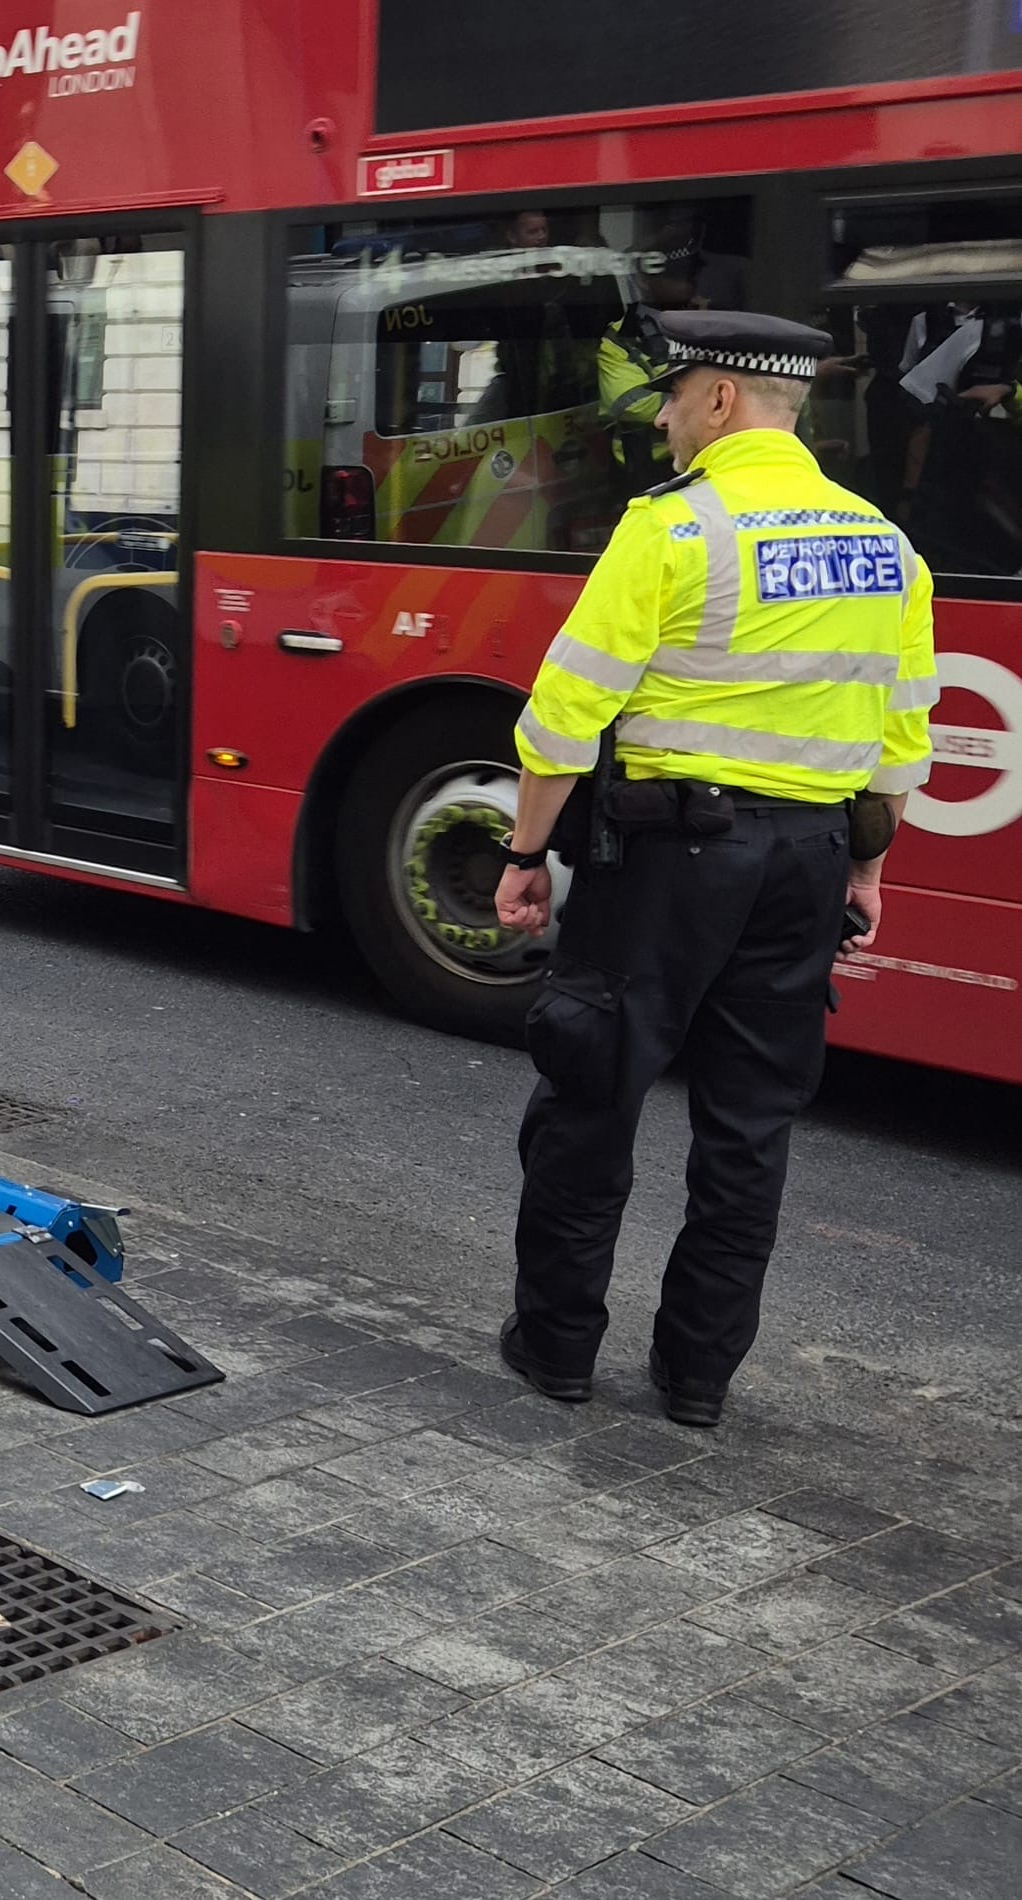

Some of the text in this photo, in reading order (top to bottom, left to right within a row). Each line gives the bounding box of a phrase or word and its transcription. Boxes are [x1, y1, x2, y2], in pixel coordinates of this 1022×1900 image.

[47, 66, 136, 98] LONDON
[761, 537, 894, 562] METROPOLITAN
[765, 556, 899, 593] POLICE
[391, 611, 435, 637] AF
[932, 735, 995, 758] USES
